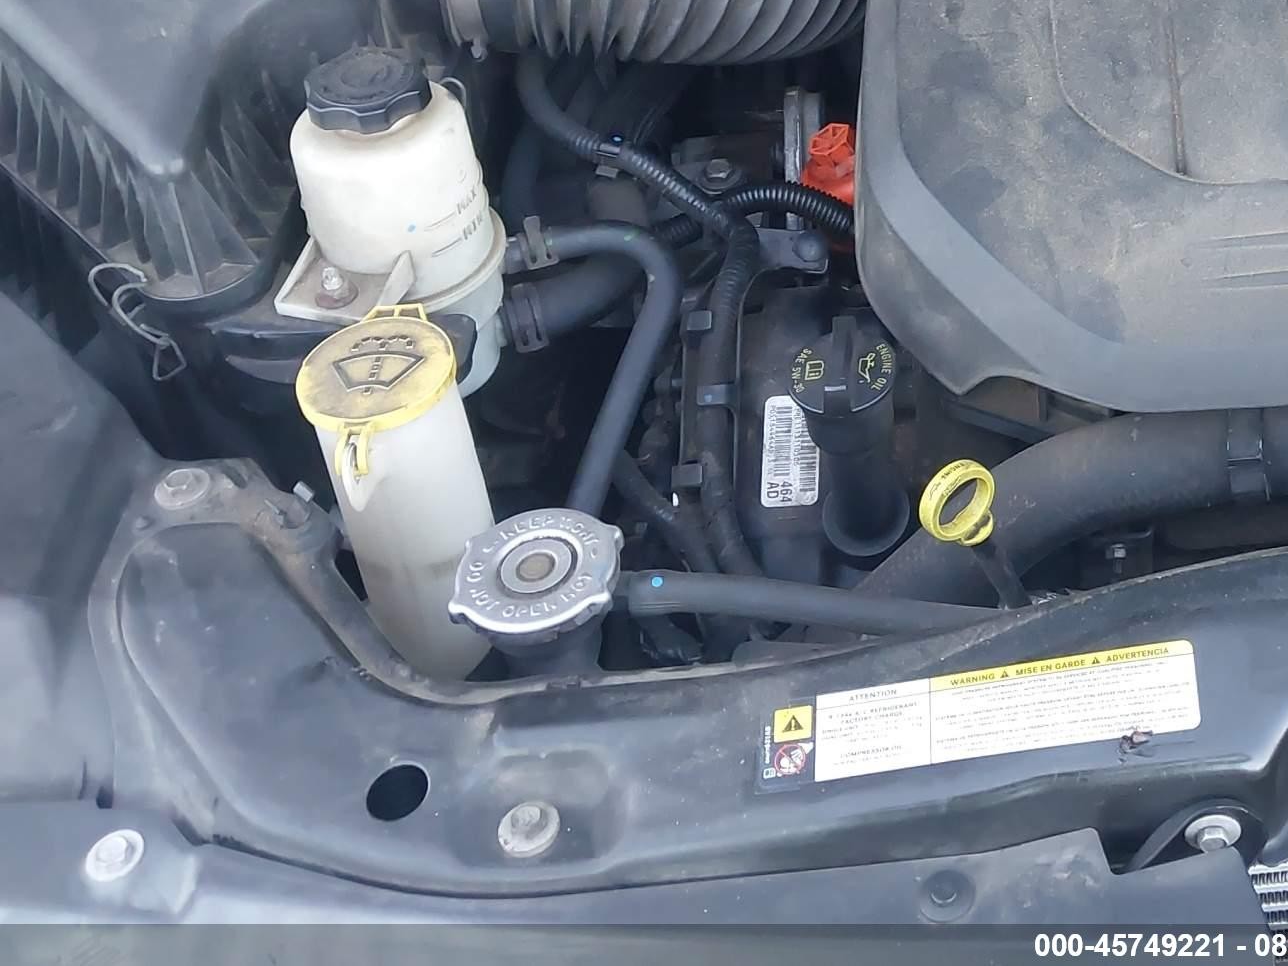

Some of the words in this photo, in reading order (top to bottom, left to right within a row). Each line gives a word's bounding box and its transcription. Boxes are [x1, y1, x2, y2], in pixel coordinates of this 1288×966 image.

[795, 348, 812, 364] SAE
[876, 343, 893, 375] ENGINE
[871, 377, 887, 391] OIL
[767, 481, 779, 499] AD
[780, 480, 792, 503] 464
[950, 673, 995, 686] WARNING
[1015, 667, 1038, 676] MISE
[1055, 659, 1086, 670] GARDE
[1106, 647, 1169, 663] ADVERTENCIA
[850, 689, 898, 702] ATTENTION
